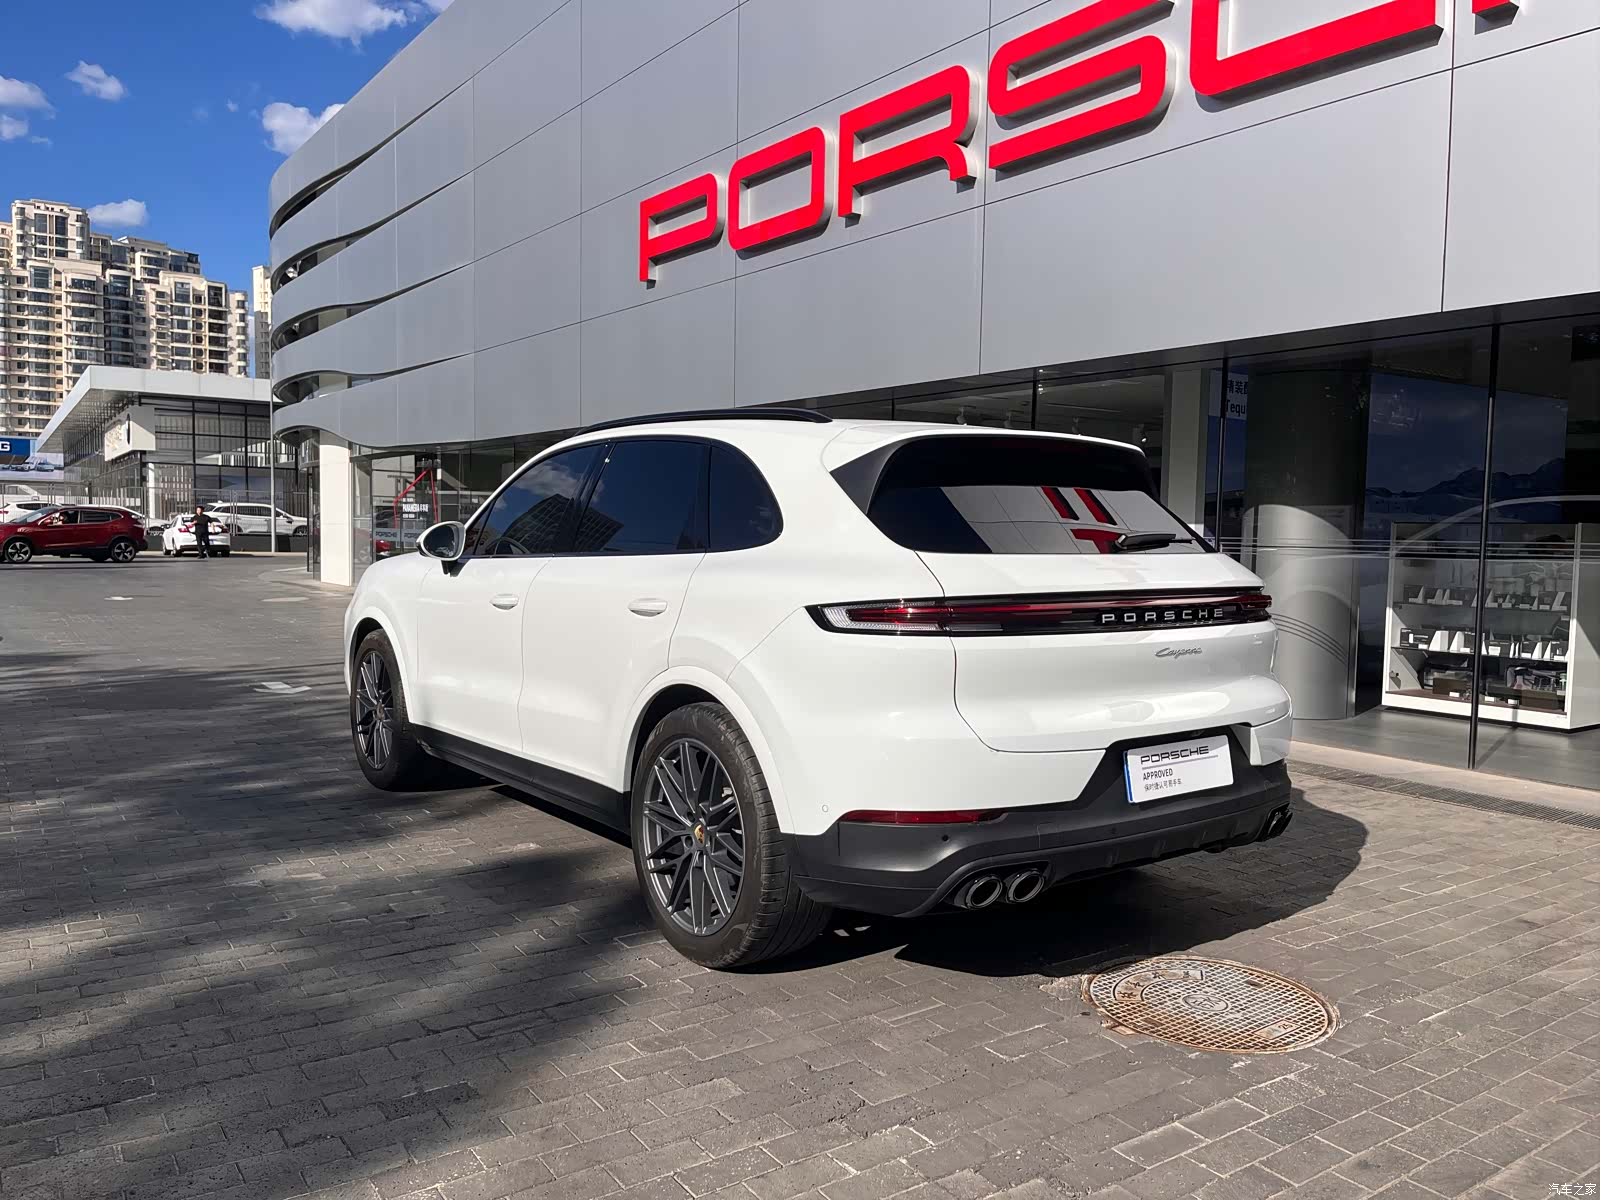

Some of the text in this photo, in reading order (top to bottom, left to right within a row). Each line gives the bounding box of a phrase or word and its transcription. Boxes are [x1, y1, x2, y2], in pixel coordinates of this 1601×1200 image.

[639, 0, 1513, 282] PORS
[1102, 608, 1223, 624] PORSCHE
[1140, 745, 1210, 765] PORSCHE
[1142, 768, 1174, 781] APPROVED
